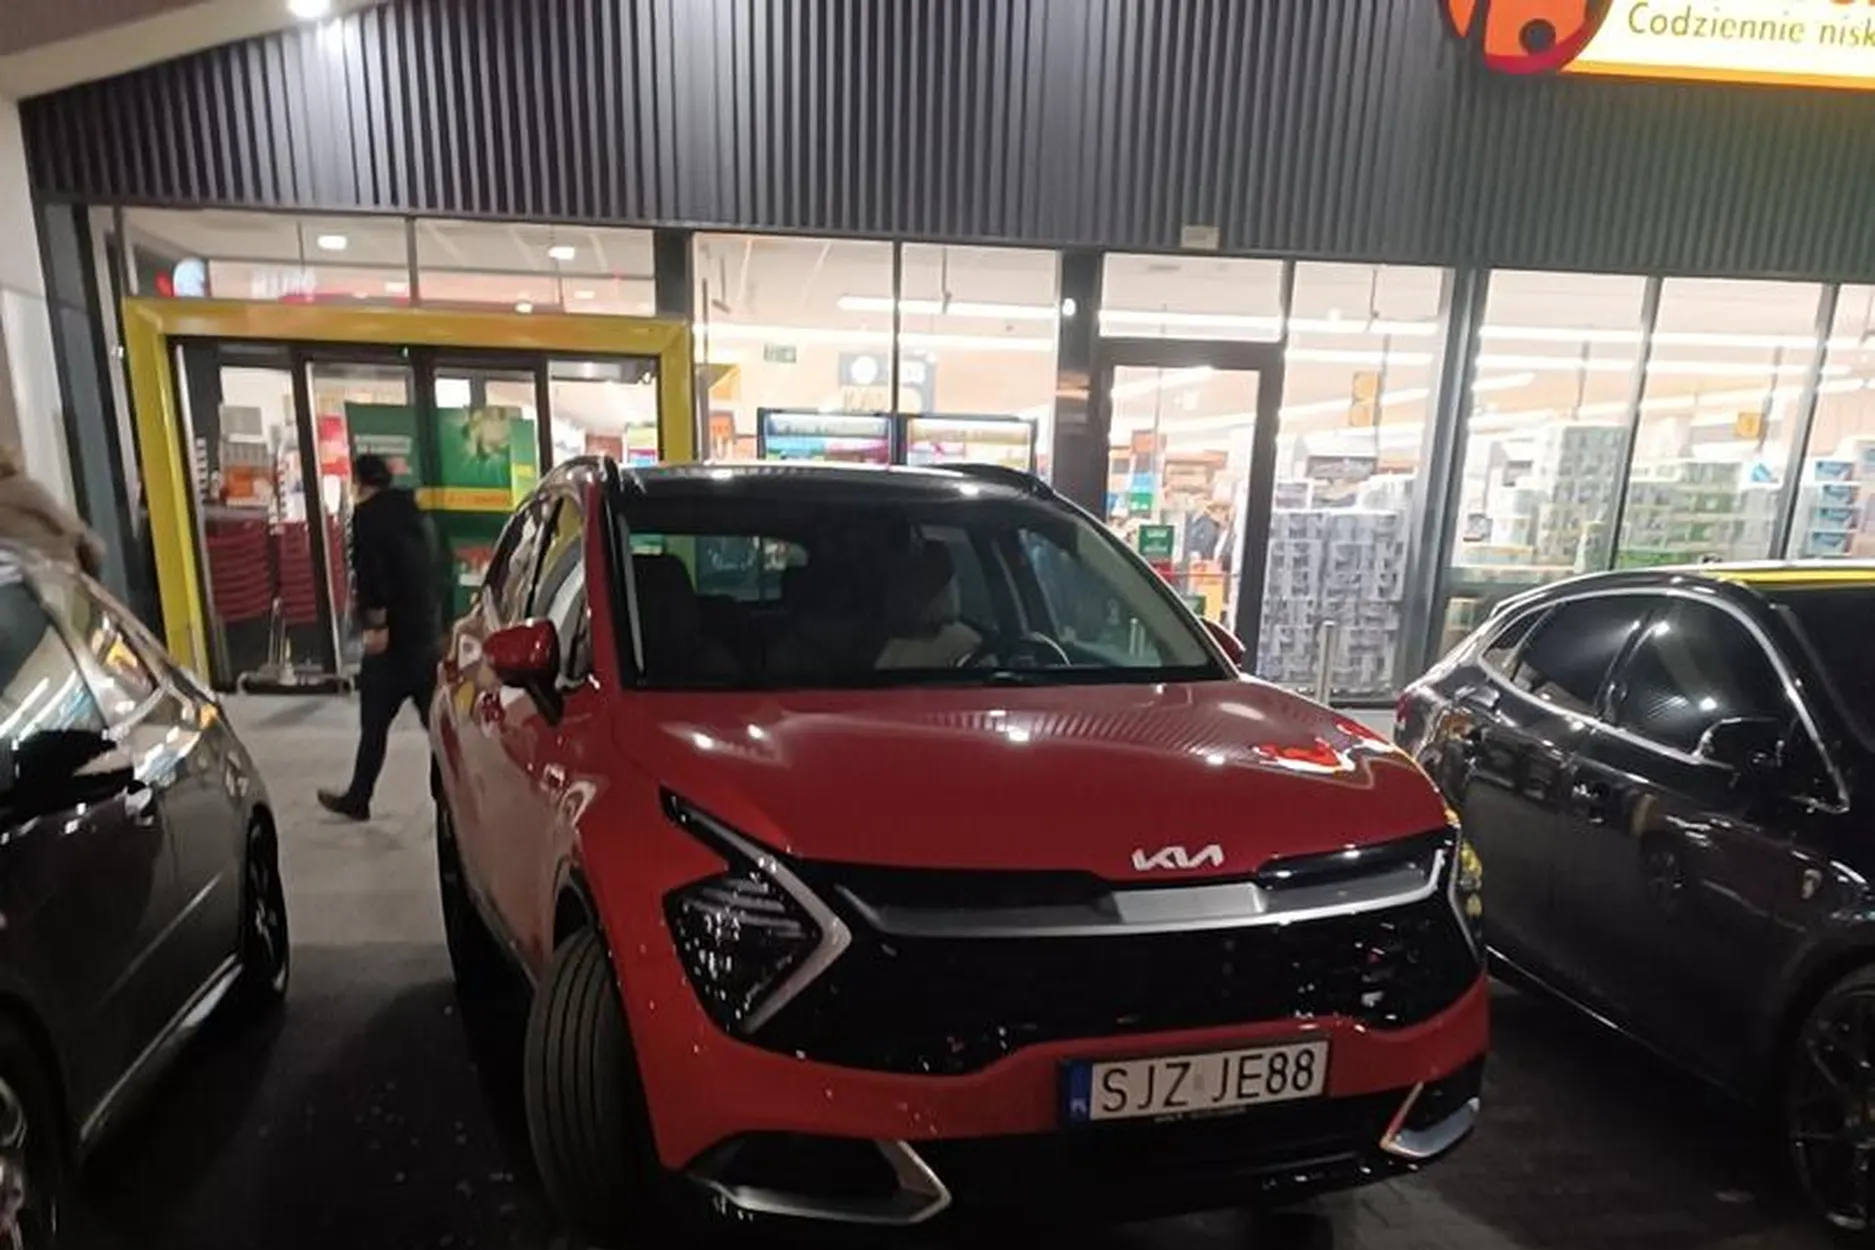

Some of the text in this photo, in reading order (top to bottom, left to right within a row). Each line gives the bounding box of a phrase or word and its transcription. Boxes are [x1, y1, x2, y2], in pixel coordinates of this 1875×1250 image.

[1628, 1, 1805, 43] Codziennie
[1131, 844, 1224, 871] KIA
[1102, 1048, 1316, 1112] SJZ JE88
